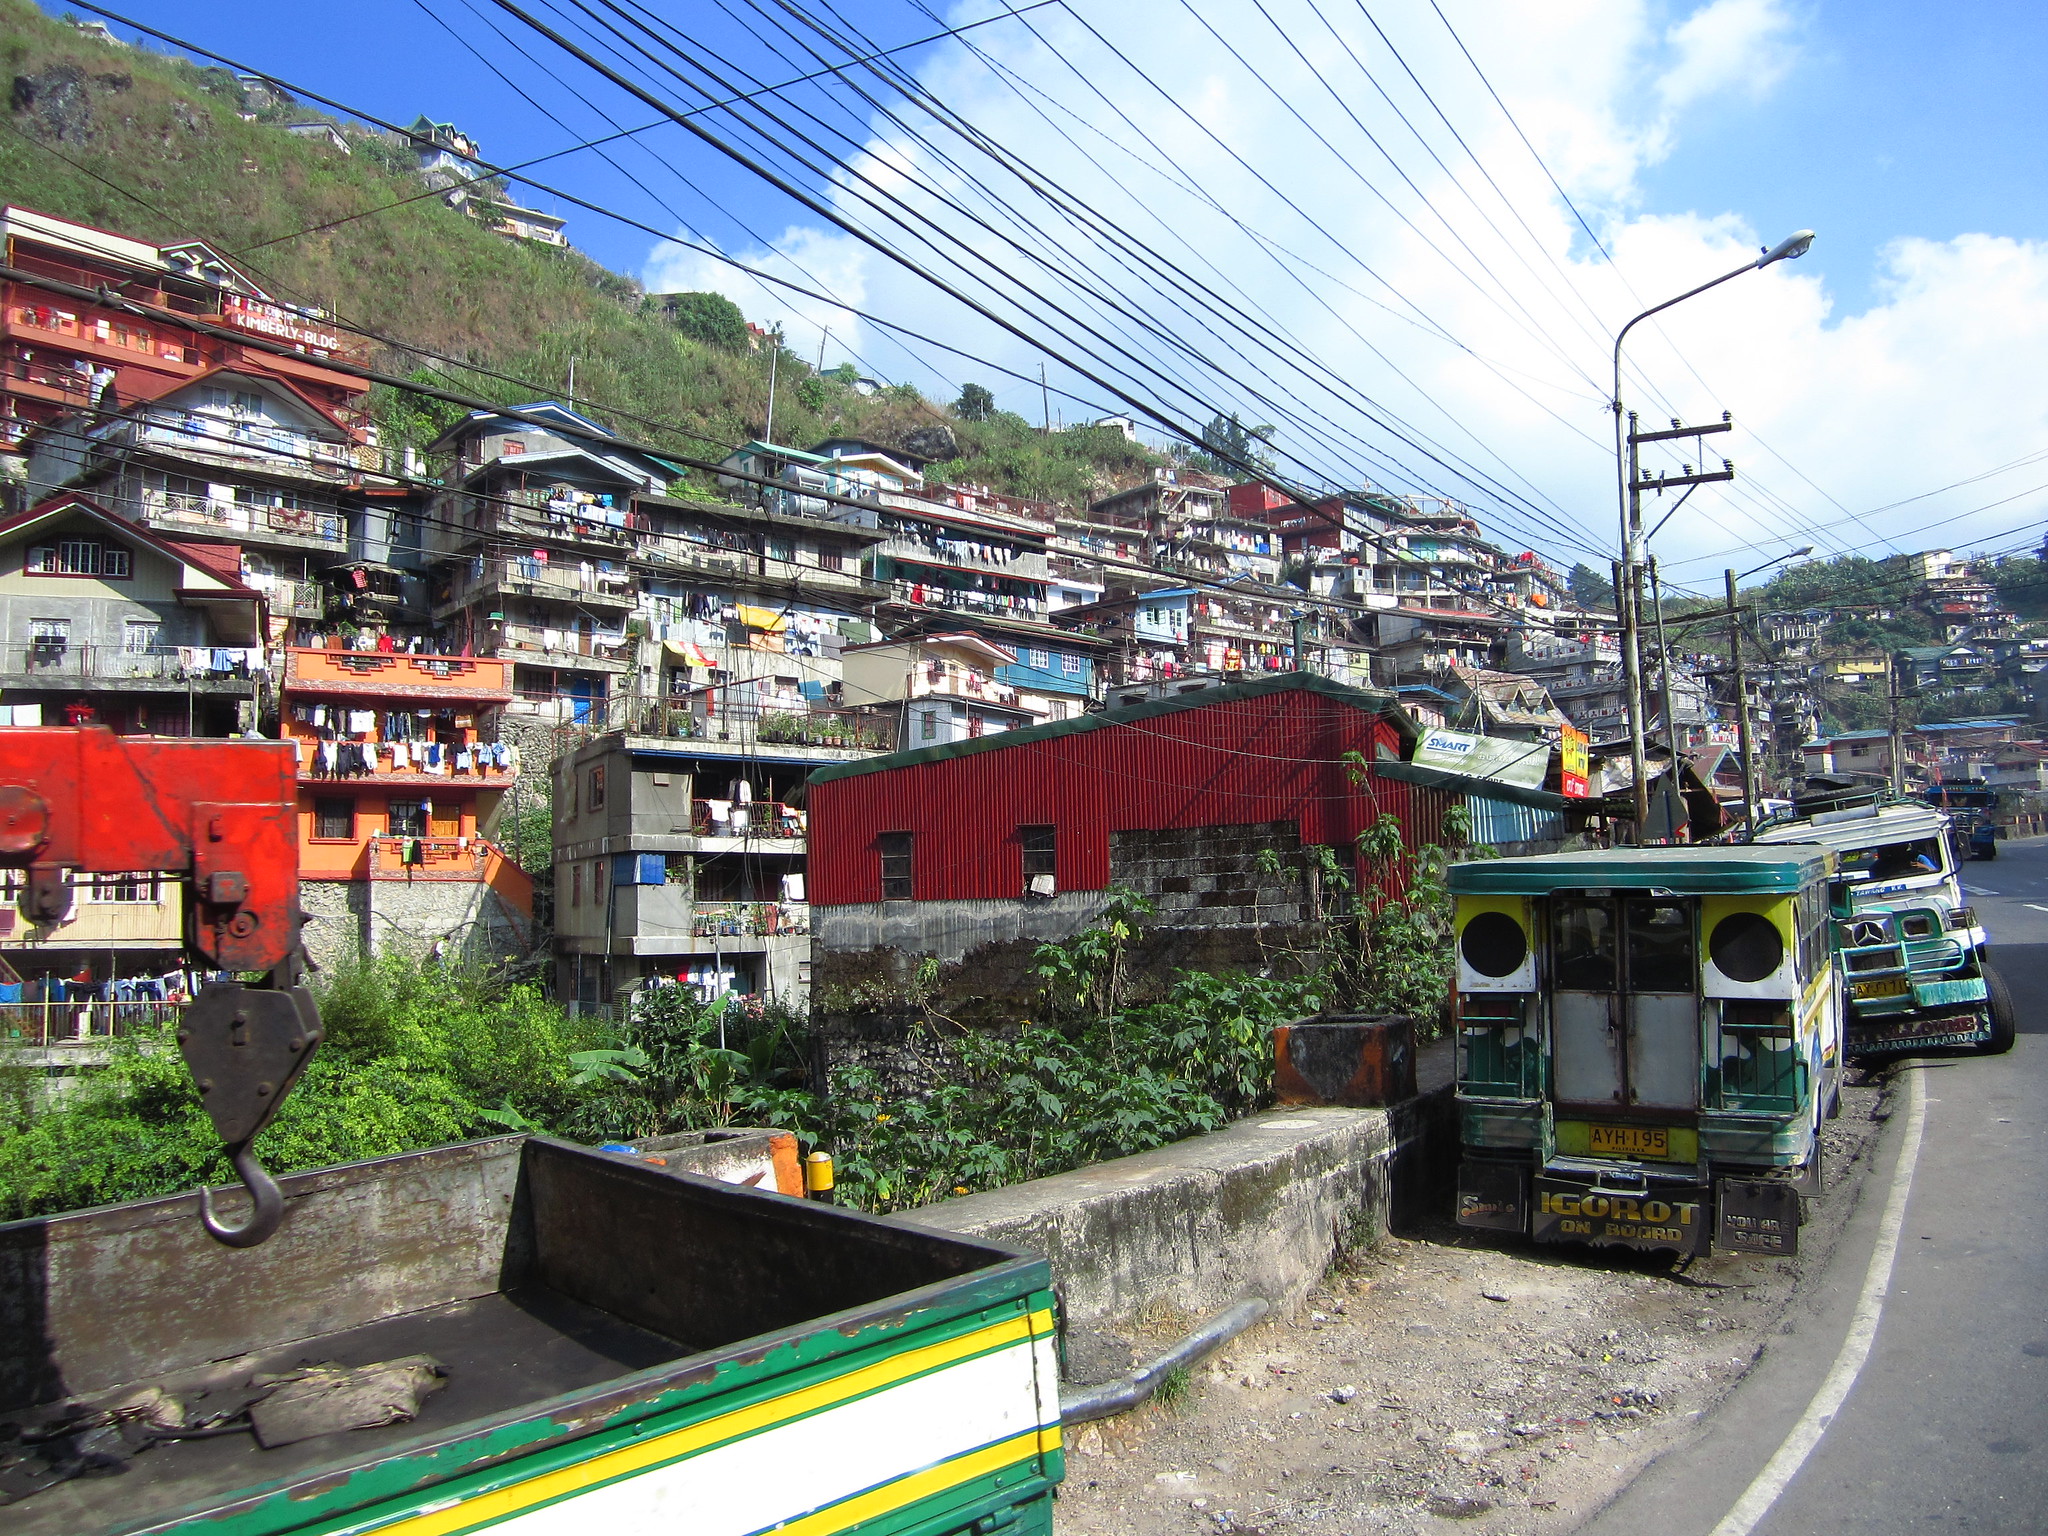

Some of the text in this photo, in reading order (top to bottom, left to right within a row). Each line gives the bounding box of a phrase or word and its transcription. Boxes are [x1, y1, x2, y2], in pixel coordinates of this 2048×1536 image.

[1427, 738, 1470, 752] SMART
[1541, 1191, 1700, 1225] IGOROT
[1560, 1219, 1684, 1242] ON BOARD
[1726, 1214, 1791, 1234] YOU ARE
[1735, 1230, 1782, 1248] SAFE
